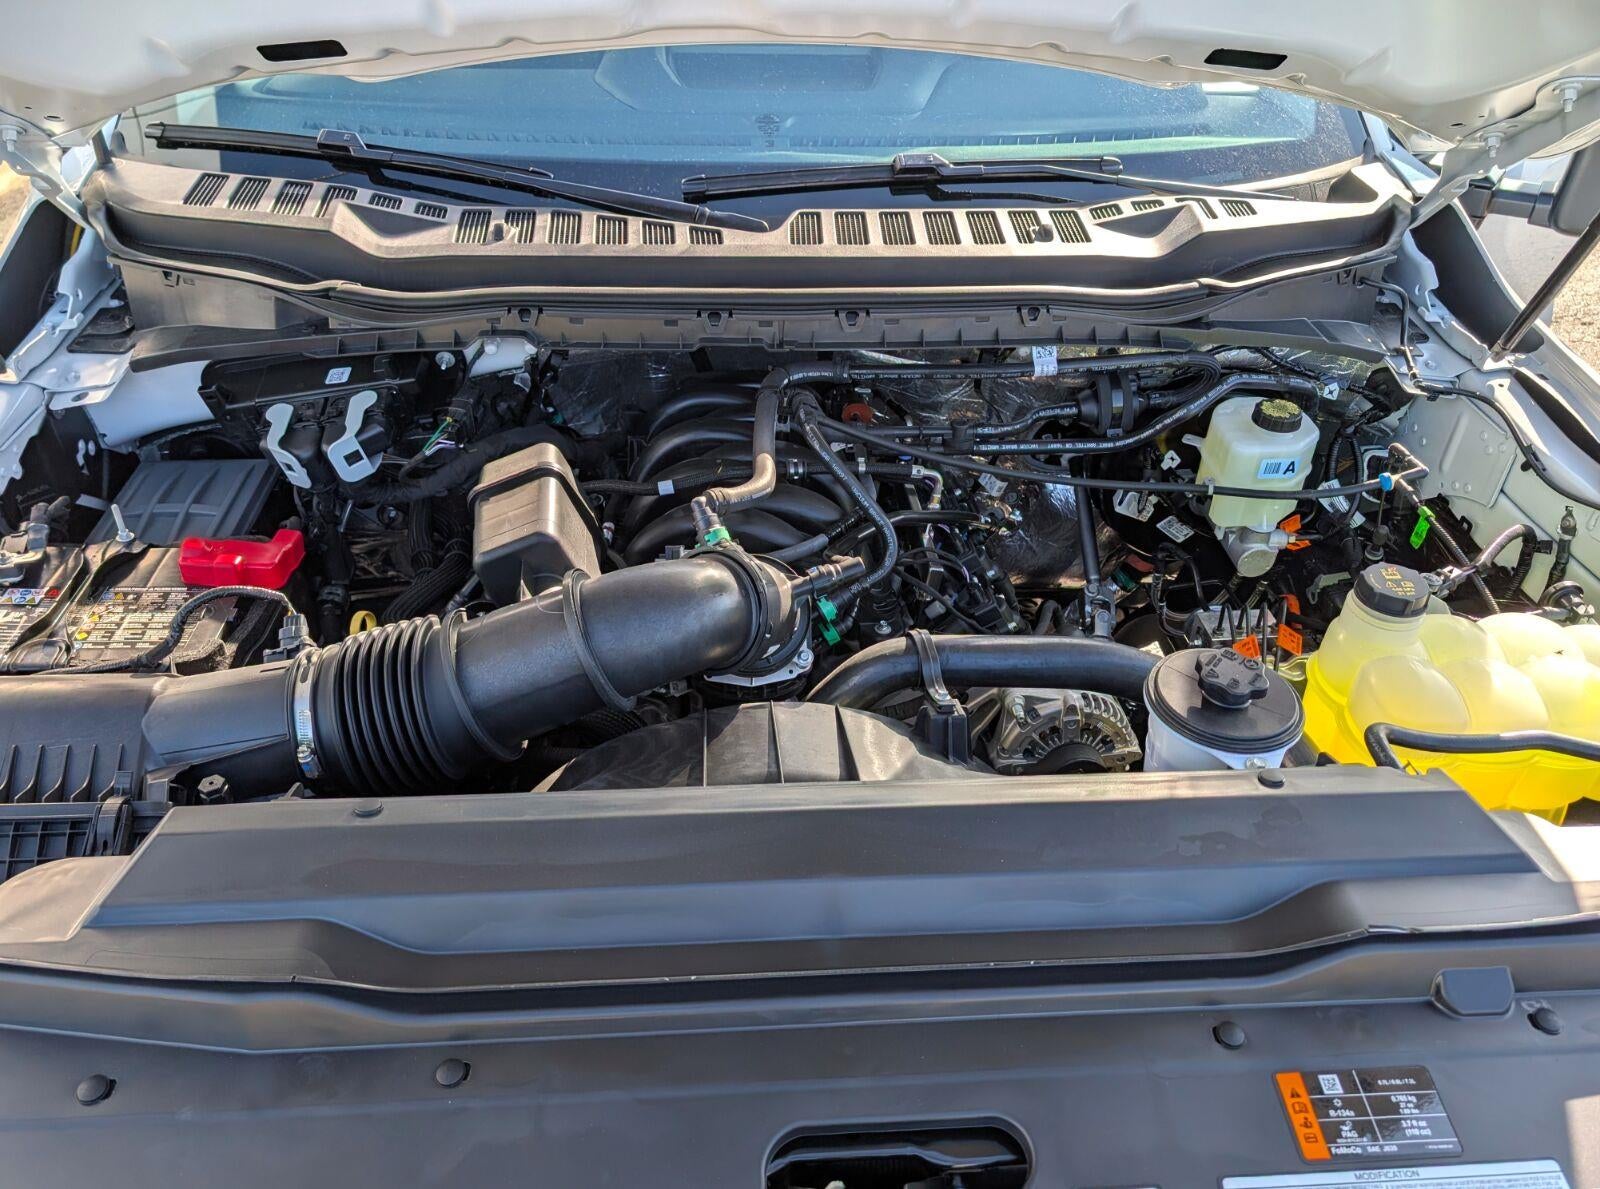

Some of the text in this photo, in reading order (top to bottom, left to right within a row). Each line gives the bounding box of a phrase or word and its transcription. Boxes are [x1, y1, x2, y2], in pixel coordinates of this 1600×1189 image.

[1283, 461, 1295, 475] A
[1331, 1145, 1363, 1155] FoMoCo
[1366, 1145, 1381, 1153] SAE
[1354, 1169, 1420, 1180] MODIFICATION
